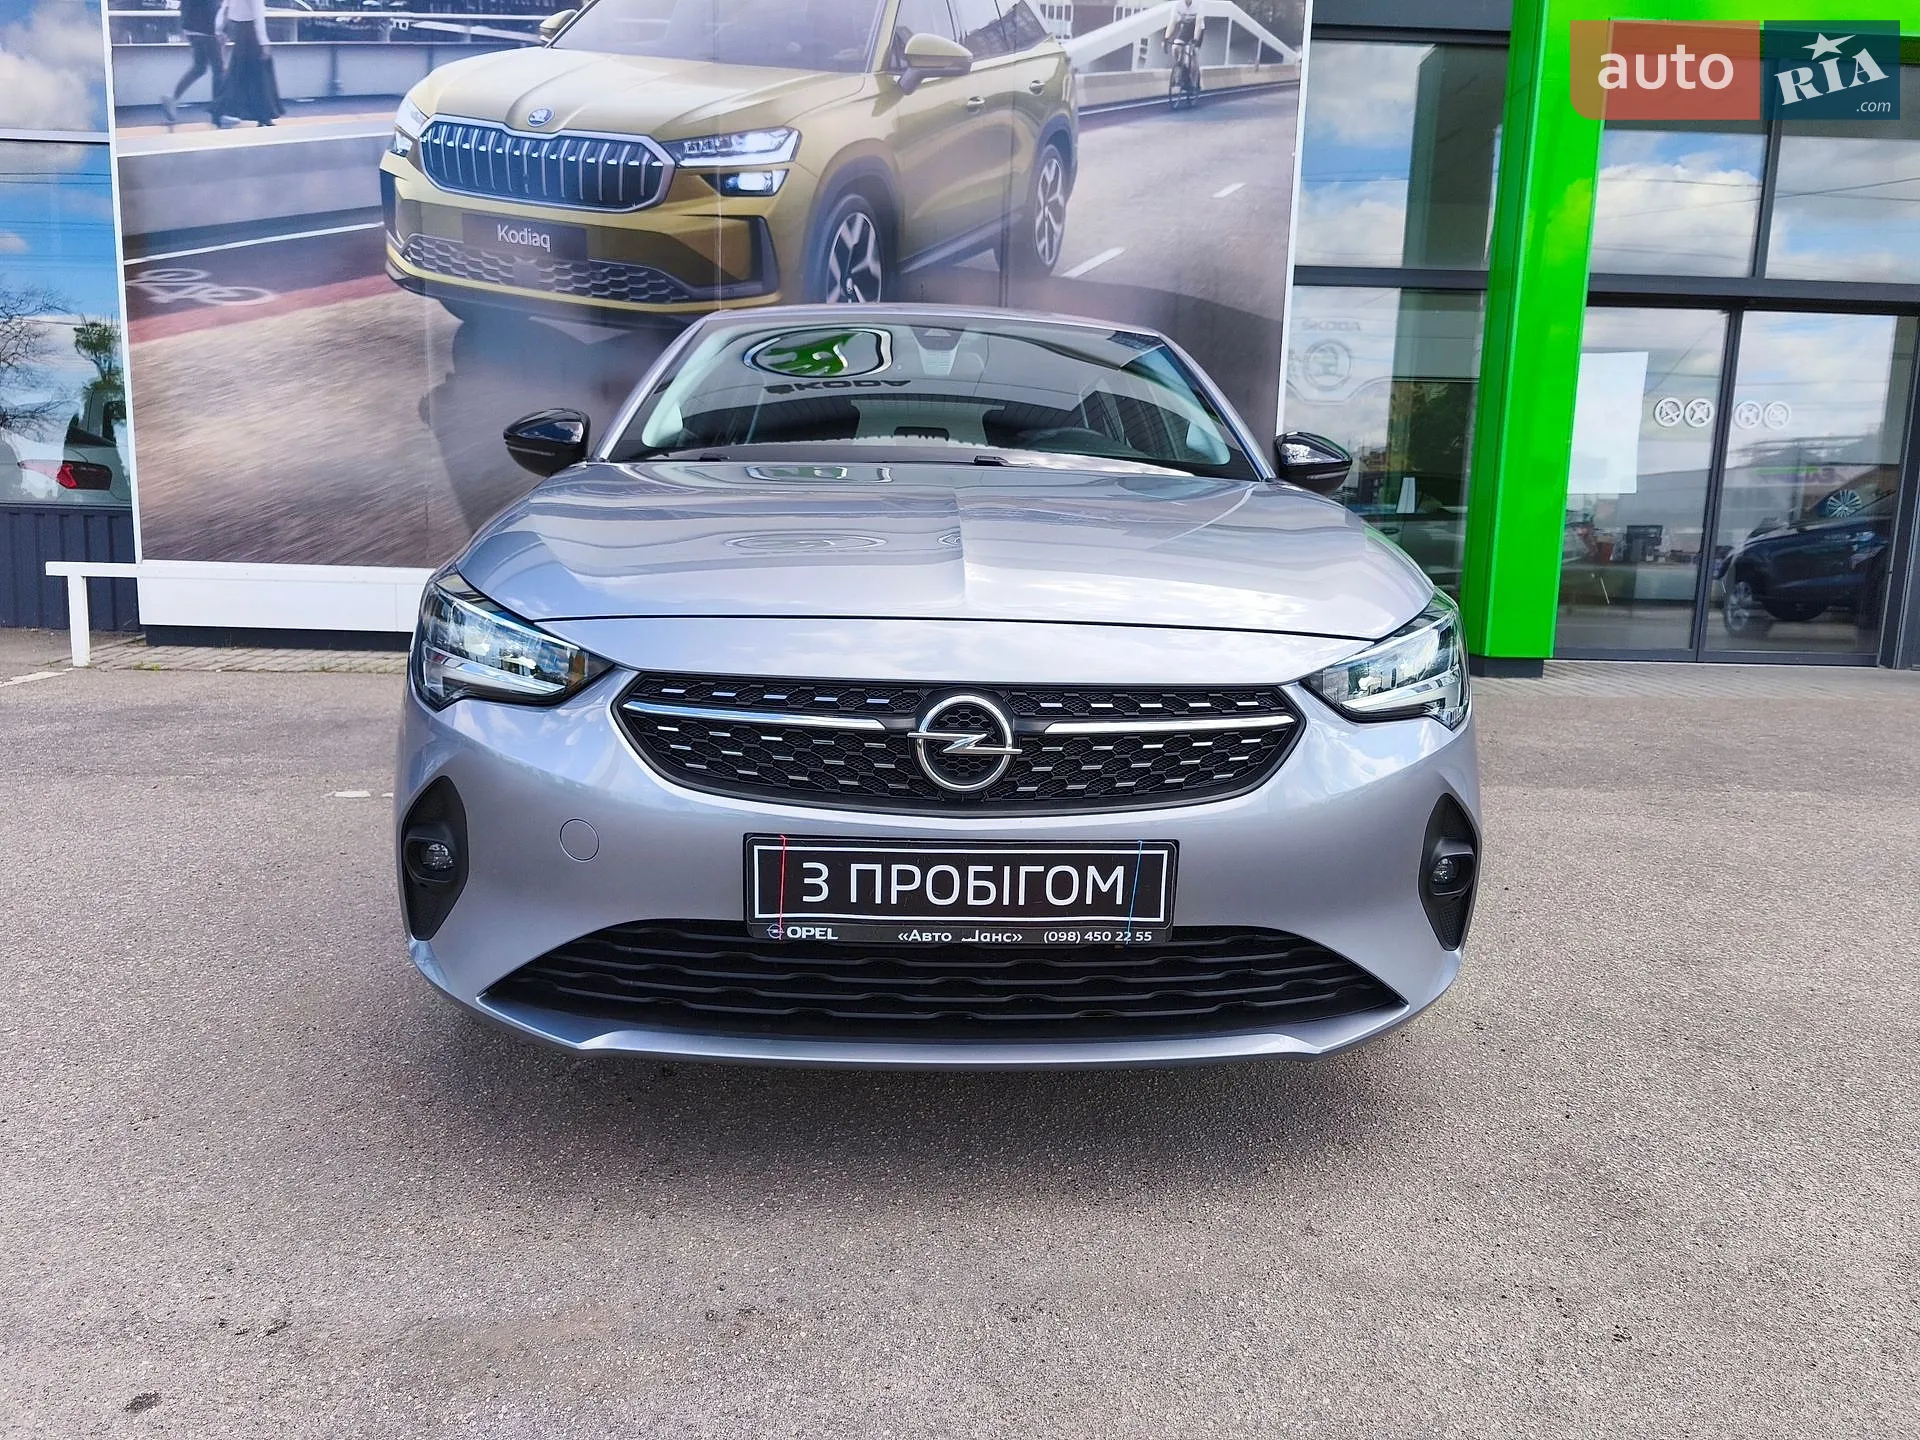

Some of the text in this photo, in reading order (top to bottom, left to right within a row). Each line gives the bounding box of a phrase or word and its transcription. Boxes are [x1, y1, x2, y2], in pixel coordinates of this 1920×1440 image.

[496, 223, 551, 253] Kodiaq
[802, 861, 1125, 907] З ПРОБІГОМ
[786, 926, 839, 940] OPEL
[1043, 930, 1152, 944] (098) 450 22 55
